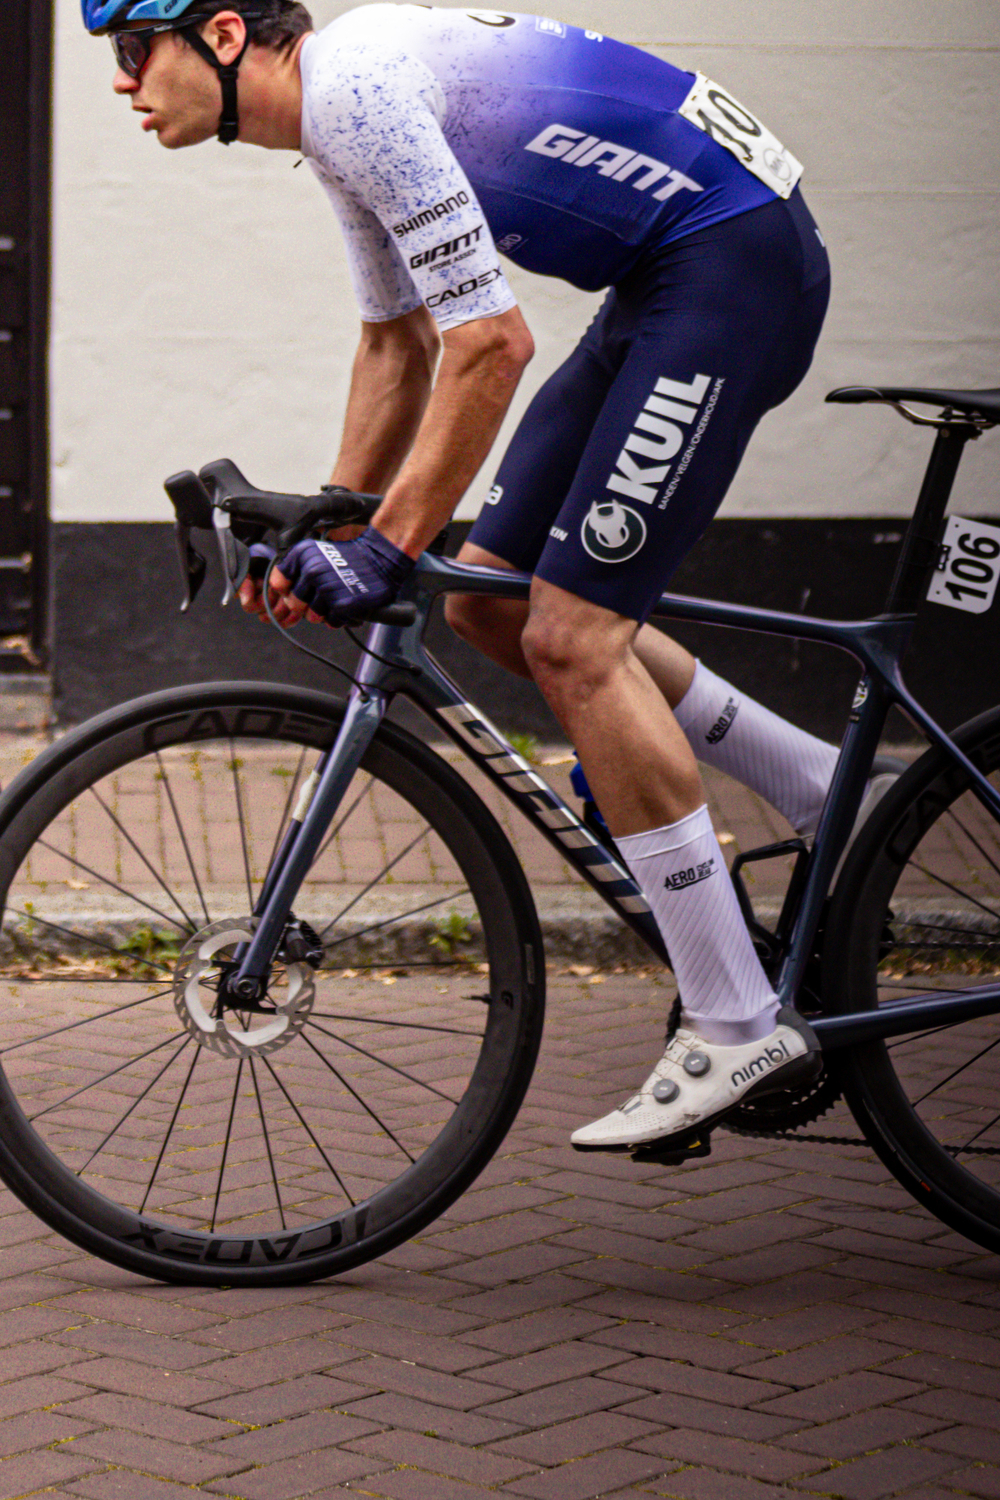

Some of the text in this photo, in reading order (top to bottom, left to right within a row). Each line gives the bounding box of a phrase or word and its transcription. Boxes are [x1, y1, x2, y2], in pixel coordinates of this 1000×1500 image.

[524, 123, 705, 201] GIANT
[393, 190, 469, 238] SHIMANO
[410, 223, 484, 269] GIANT
[425, 266, 503, 308] CADEX
[606, 373, 712, 505] KUIL
[944, 533, 1000, 601] 106
[140, 708, 337, 753] CADE
[705, 716, 728, 744] AERO
[664, 867, 696, 889] AERO
[731, 1040, 790, 1087] nimbl
[119, 1214, 348, 1265] CADEX
